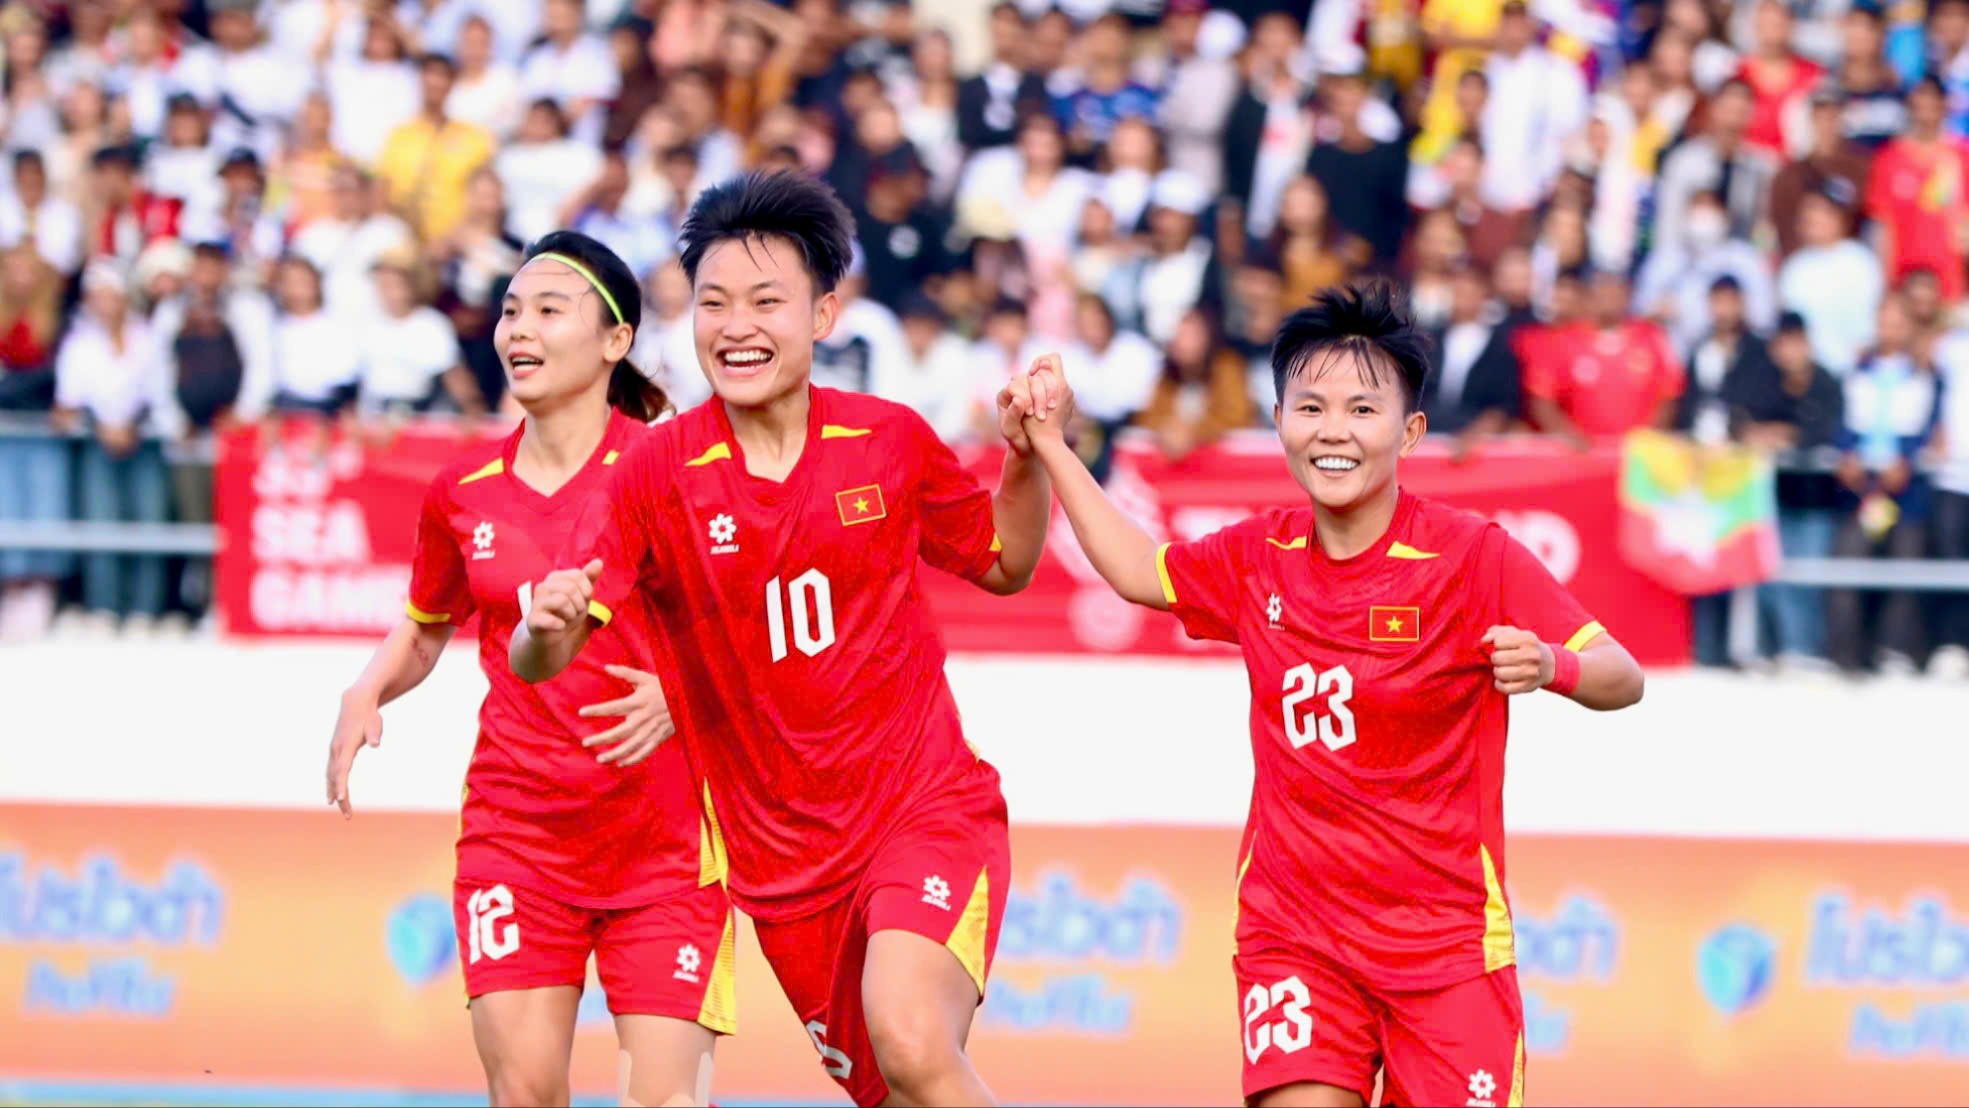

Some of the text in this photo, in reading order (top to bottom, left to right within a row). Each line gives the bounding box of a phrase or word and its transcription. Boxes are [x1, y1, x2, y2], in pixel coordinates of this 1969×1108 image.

[252, 502, 370, 562] SEA
[766, 567, 836, 663] 10
[1282, 662, 1357, 752] 23
[467, 884, 520, 965] 12
[1244, 975, 1313, 1065] 23
